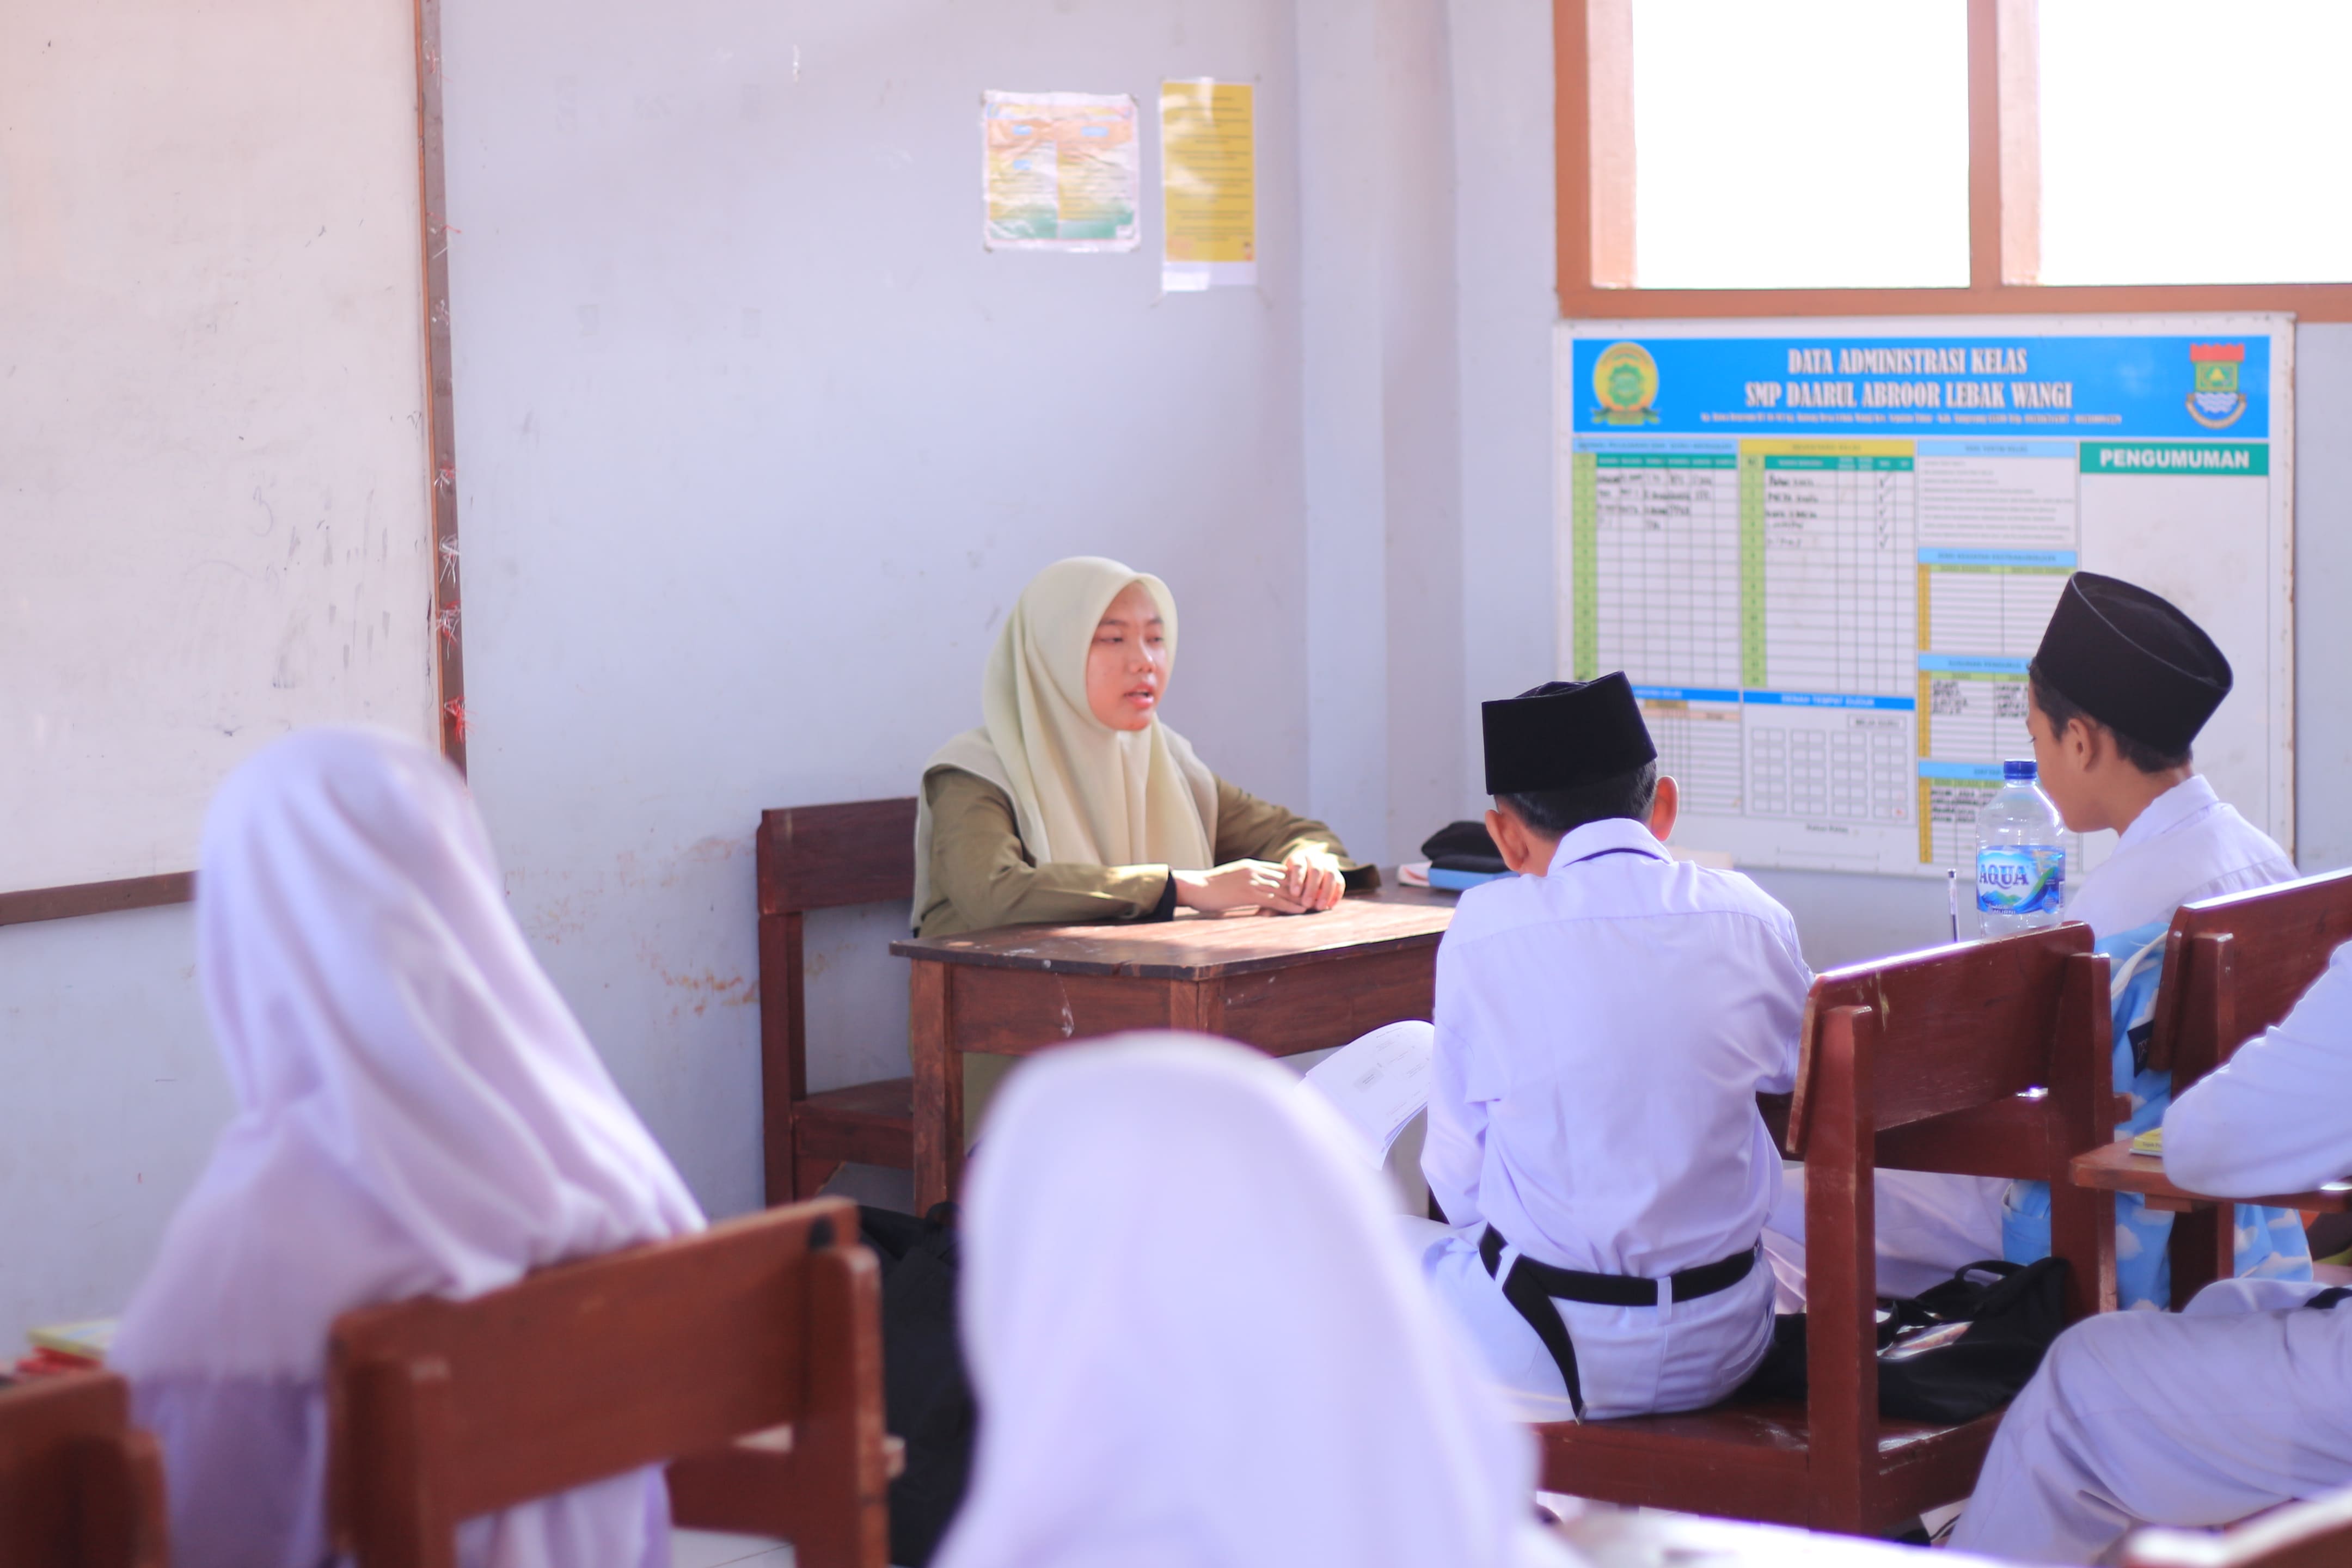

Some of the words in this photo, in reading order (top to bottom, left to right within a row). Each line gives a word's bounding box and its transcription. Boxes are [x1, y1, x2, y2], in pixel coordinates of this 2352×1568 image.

[1788, 348, 1834, 374] DATA
[1839, 348, 1967, 374] ADMINISTRASI
[1971, 348, 2028, 374] KELAS
[1745, 381, 1782, 407] SMP
[1786, 382, 1857, 407] DAARUL
[1862, 382, 1941, 408] ABROOR
[1945, 382, 2006, 408] LEBAK
[2011, 382, 2073, 408] WANGI
[2100, 448, 2250, 469] PENGUMUMAN
[1979, 864, 2030, 889] AQUA
